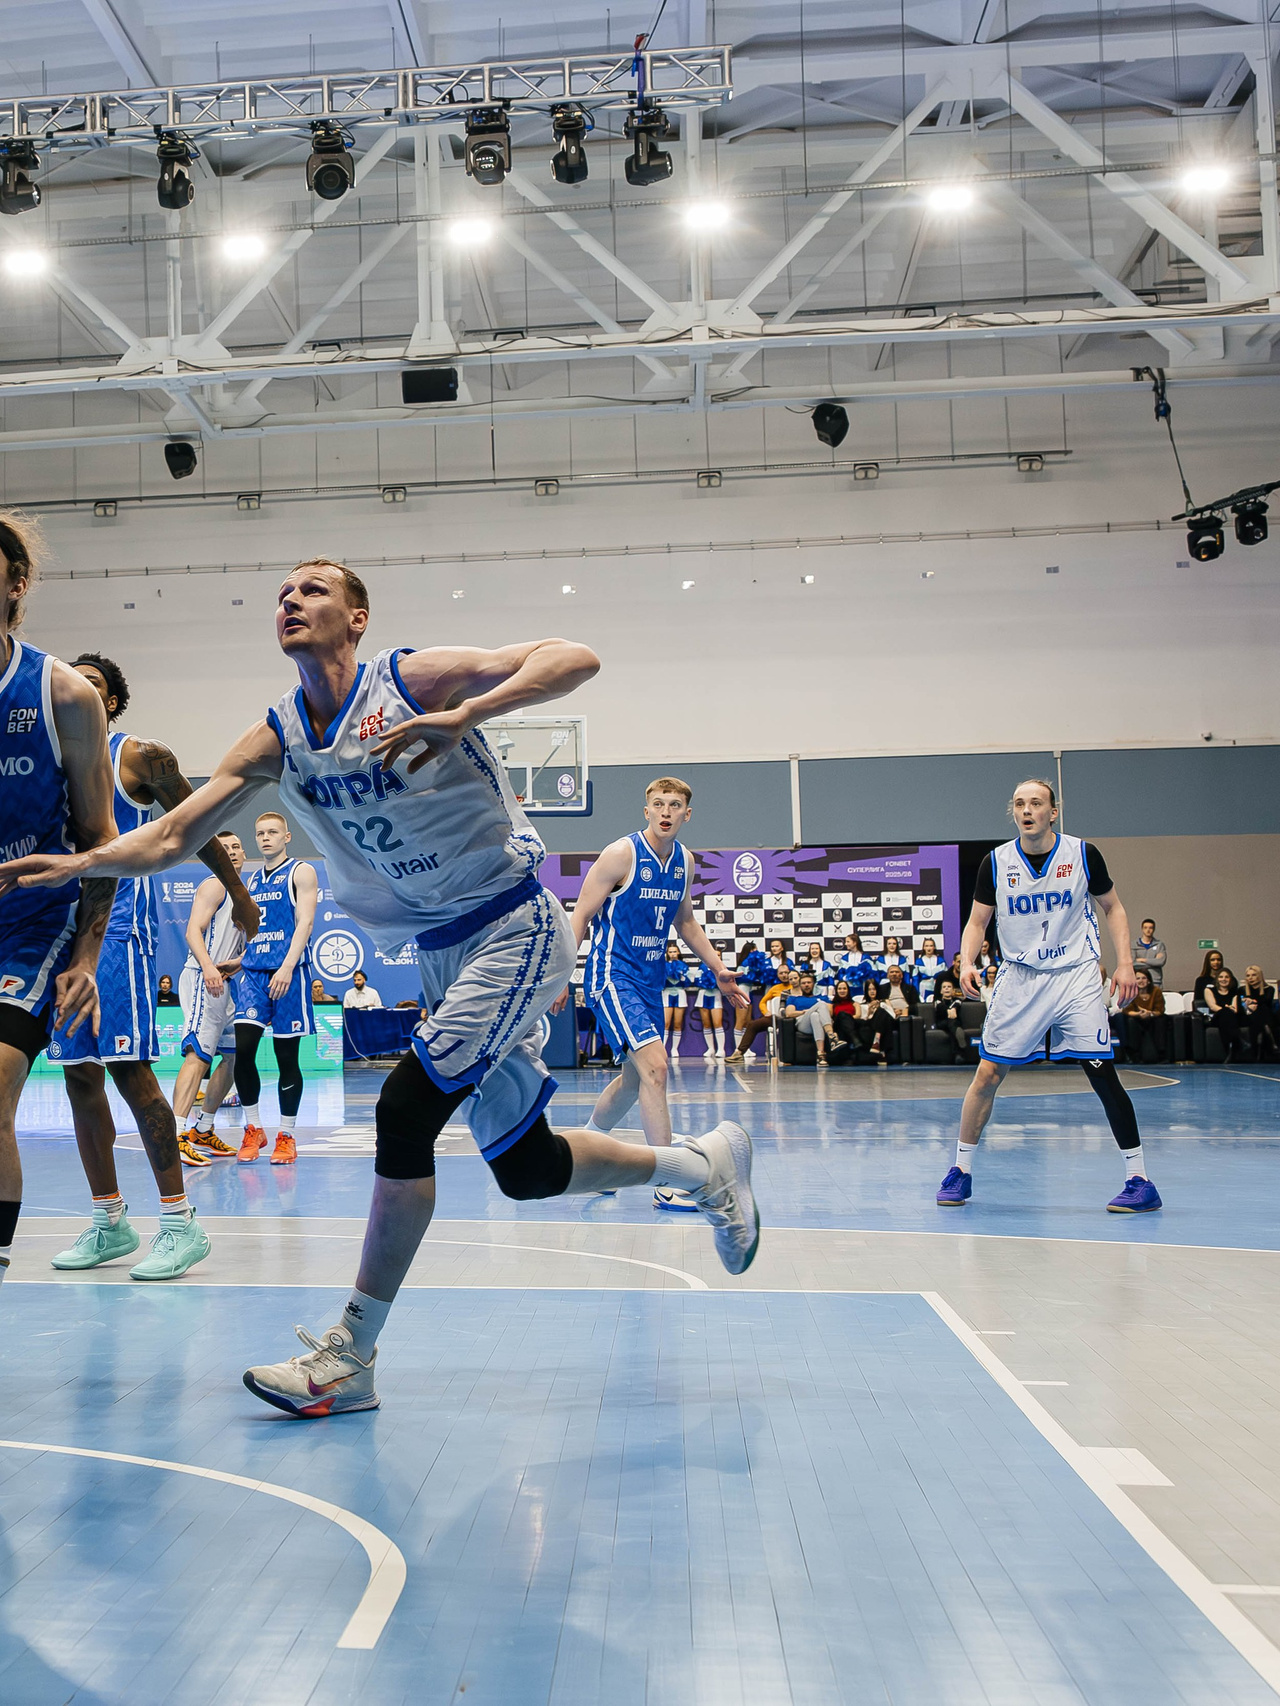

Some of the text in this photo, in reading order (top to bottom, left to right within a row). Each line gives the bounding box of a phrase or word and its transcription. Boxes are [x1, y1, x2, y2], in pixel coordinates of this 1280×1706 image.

[9, 708, 37, 721] FON
[7, 721, 35, 734] BET
[360, 720, 384, 741] BET
[342, 816, 404, 853] 22
[1056, 870, 1072, 878] BET
[639, 888, 681, 900] ДИНАМО
[1007, 889, 1073, 916] ЮГРА
[1041, 920, 1049, 941] 1
